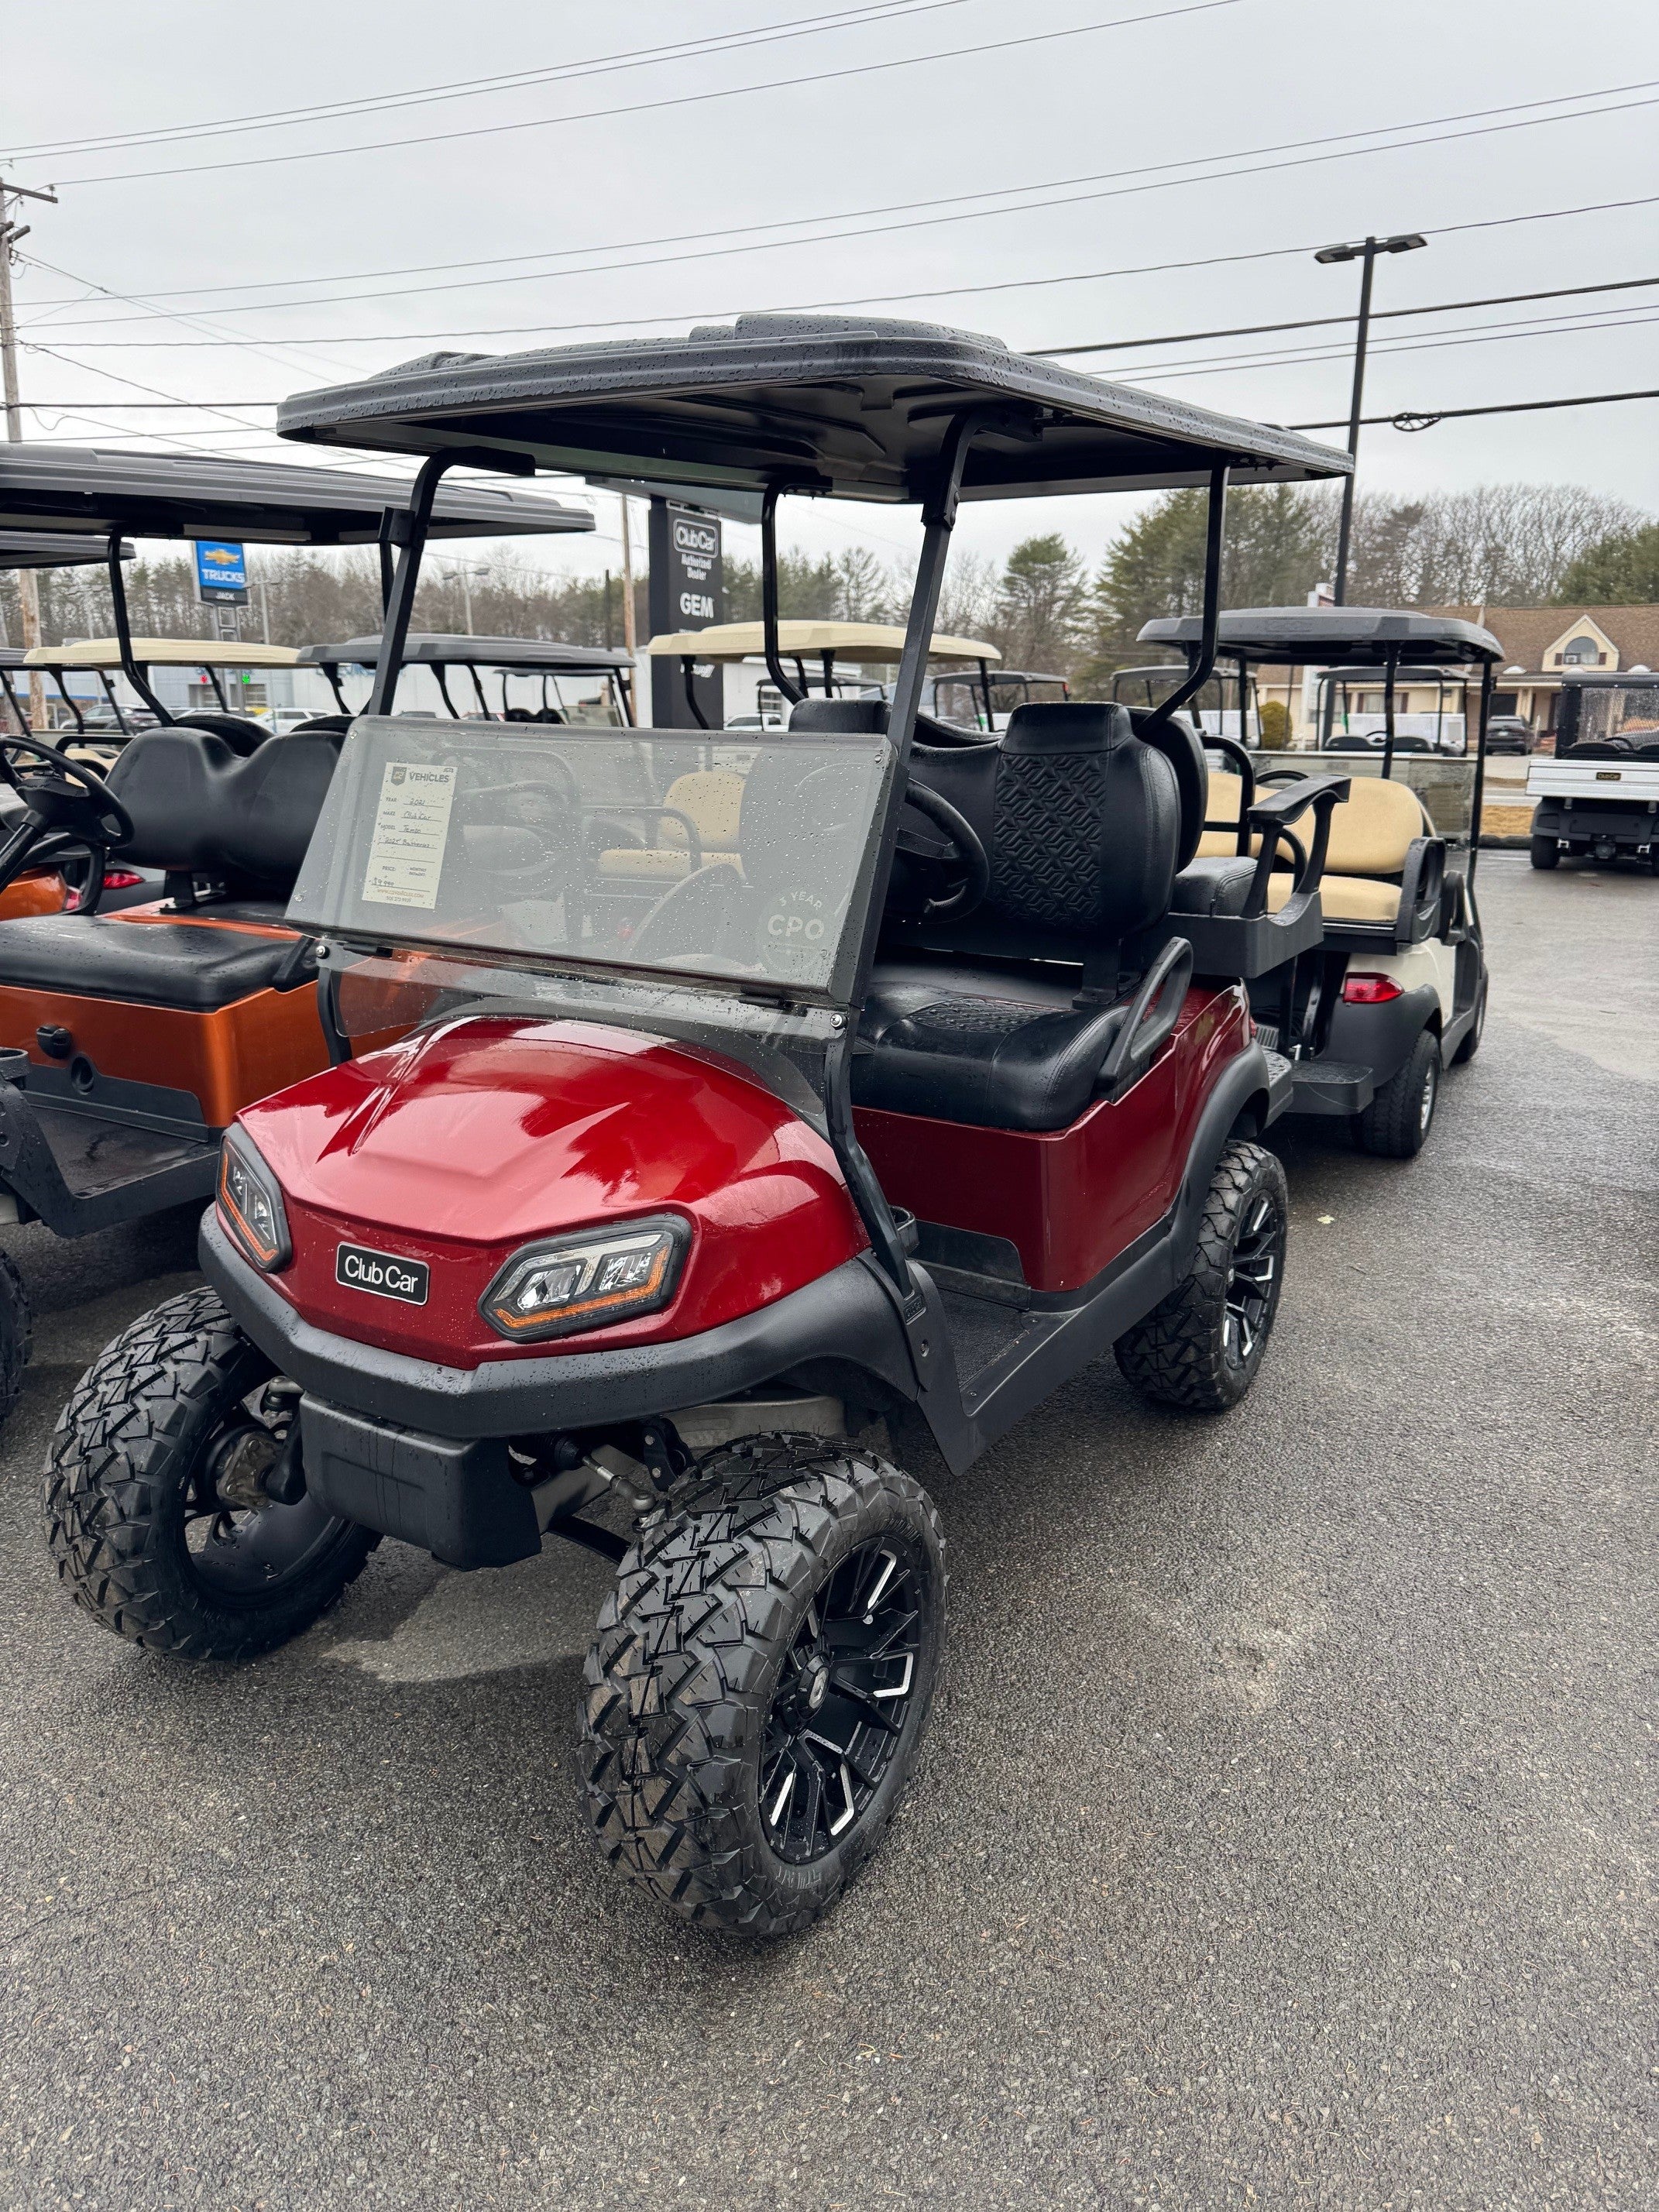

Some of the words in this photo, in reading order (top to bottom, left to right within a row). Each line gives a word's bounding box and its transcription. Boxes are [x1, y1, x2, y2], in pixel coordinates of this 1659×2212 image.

[698, 531, 715, 551] Car
[202, 568, 246, 583] TRUCKS
[687, 565, 706, 581] Dealer
[679, 592, 714, 619] GEM
[409, 771, 449, 783] VEHICLES
[791, 891, 822, 910] YEAR
[768, 914, 824, 940] CPO
[345, 1255, 383, 1285] Club
[385, 1265, 418, 1293] Car
